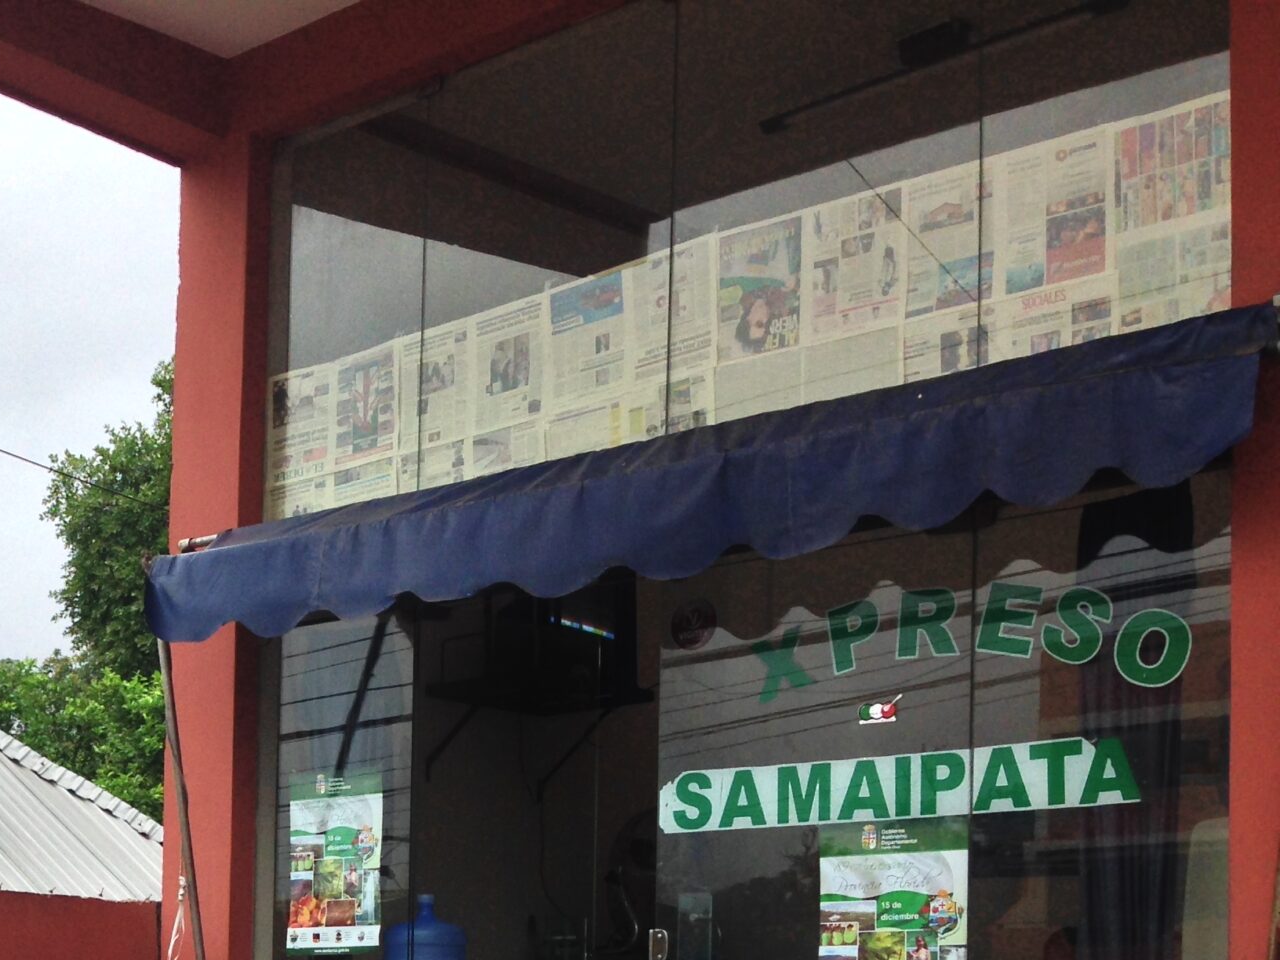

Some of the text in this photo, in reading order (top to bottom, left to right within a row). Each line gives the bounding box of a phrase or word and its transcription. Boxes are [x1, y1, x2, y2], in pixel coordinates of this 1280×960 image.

[751, 583, 1193, 704] XPRESO
[673, 737, 1141, 831] SAMAIPATA
[880, 912, 920, 921] diciembre
[891, 901, 902, 909] de
